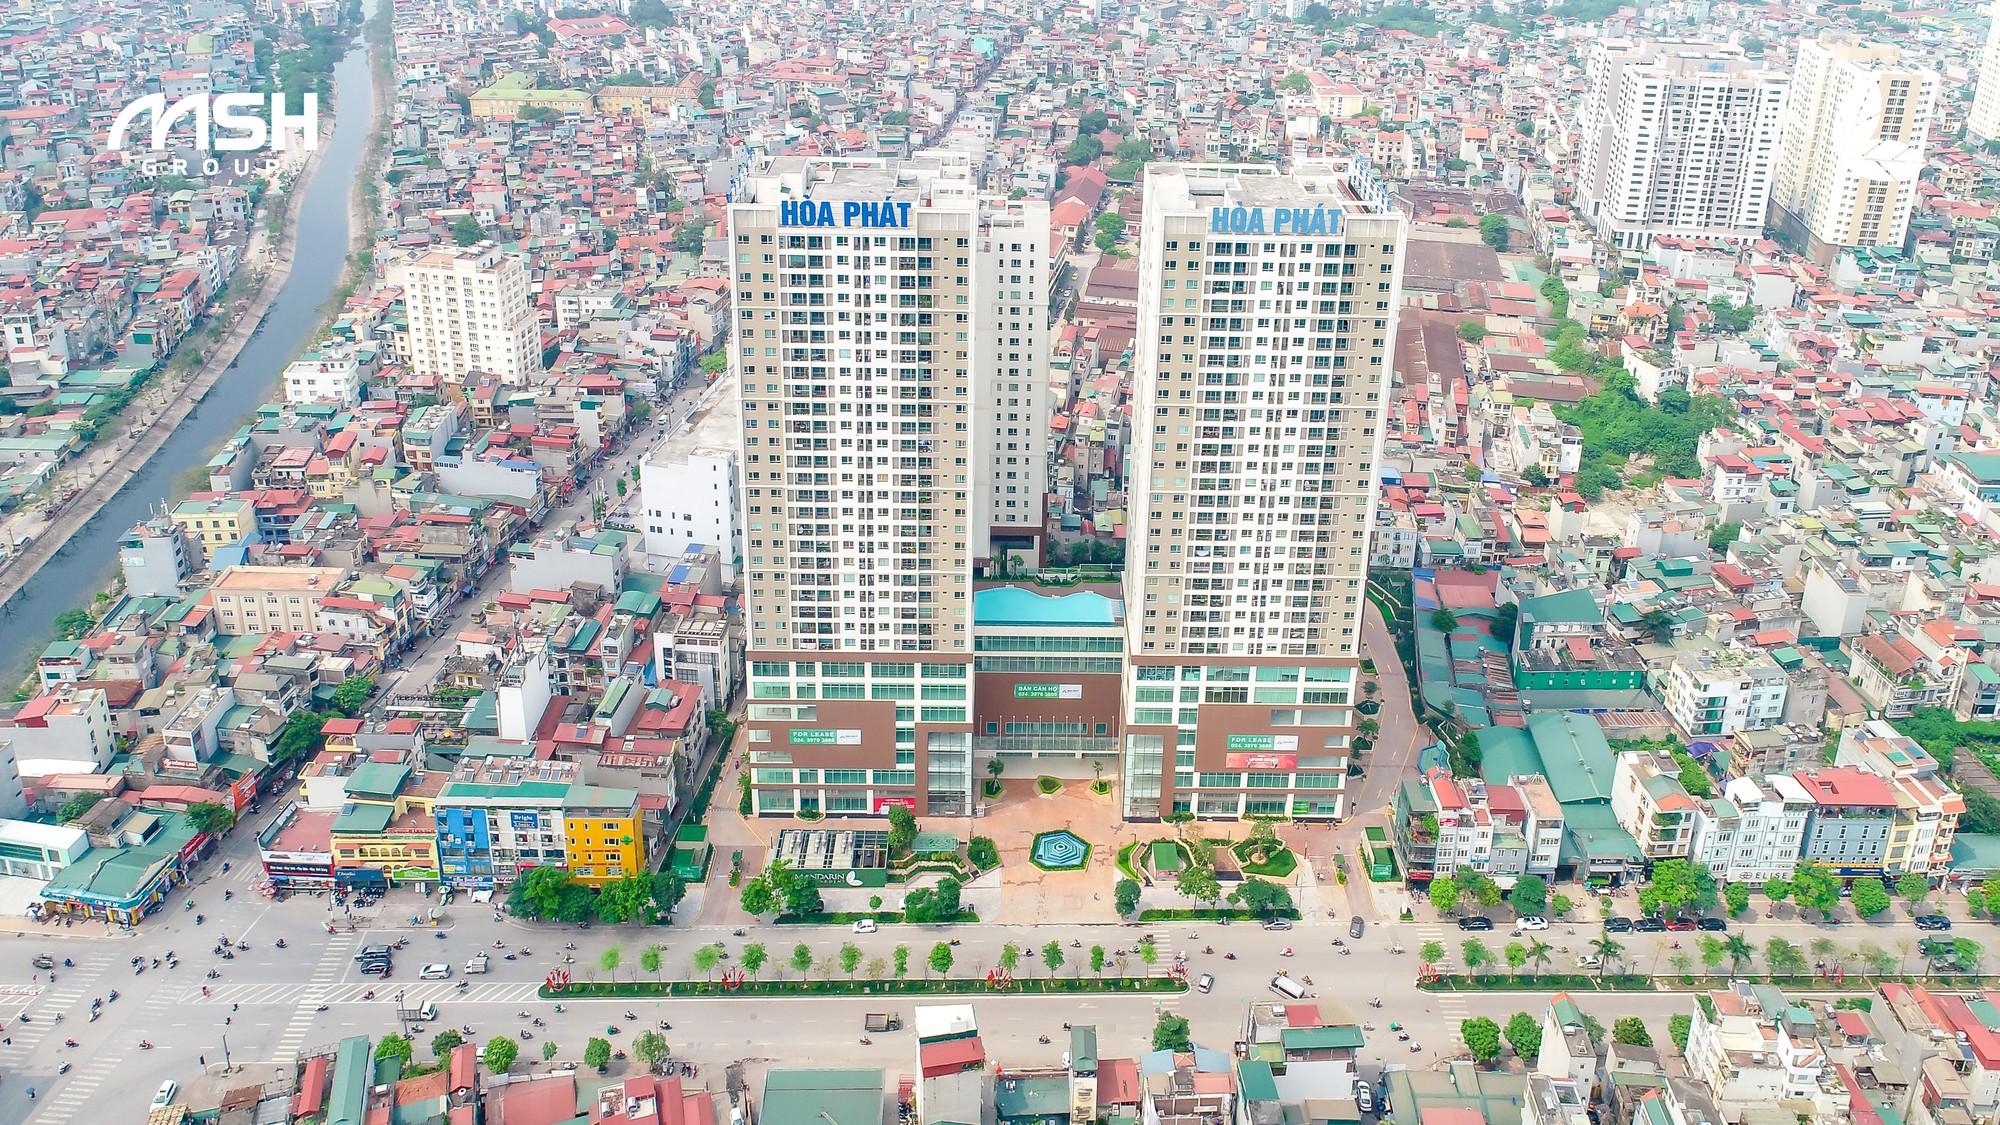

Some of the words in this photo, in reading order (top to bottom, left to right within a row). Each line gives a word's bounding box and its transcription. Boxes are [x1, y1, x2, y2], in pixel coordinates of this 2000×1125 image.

[781, 194, 835, 227] HÒA
[843, 195, 911, 228] PHÁT
[1212, 201, 1265, 234] HÒA
[1273, 202, 1343, 235] PHÁT
[1755, 871, 1788, 880] ELISE
